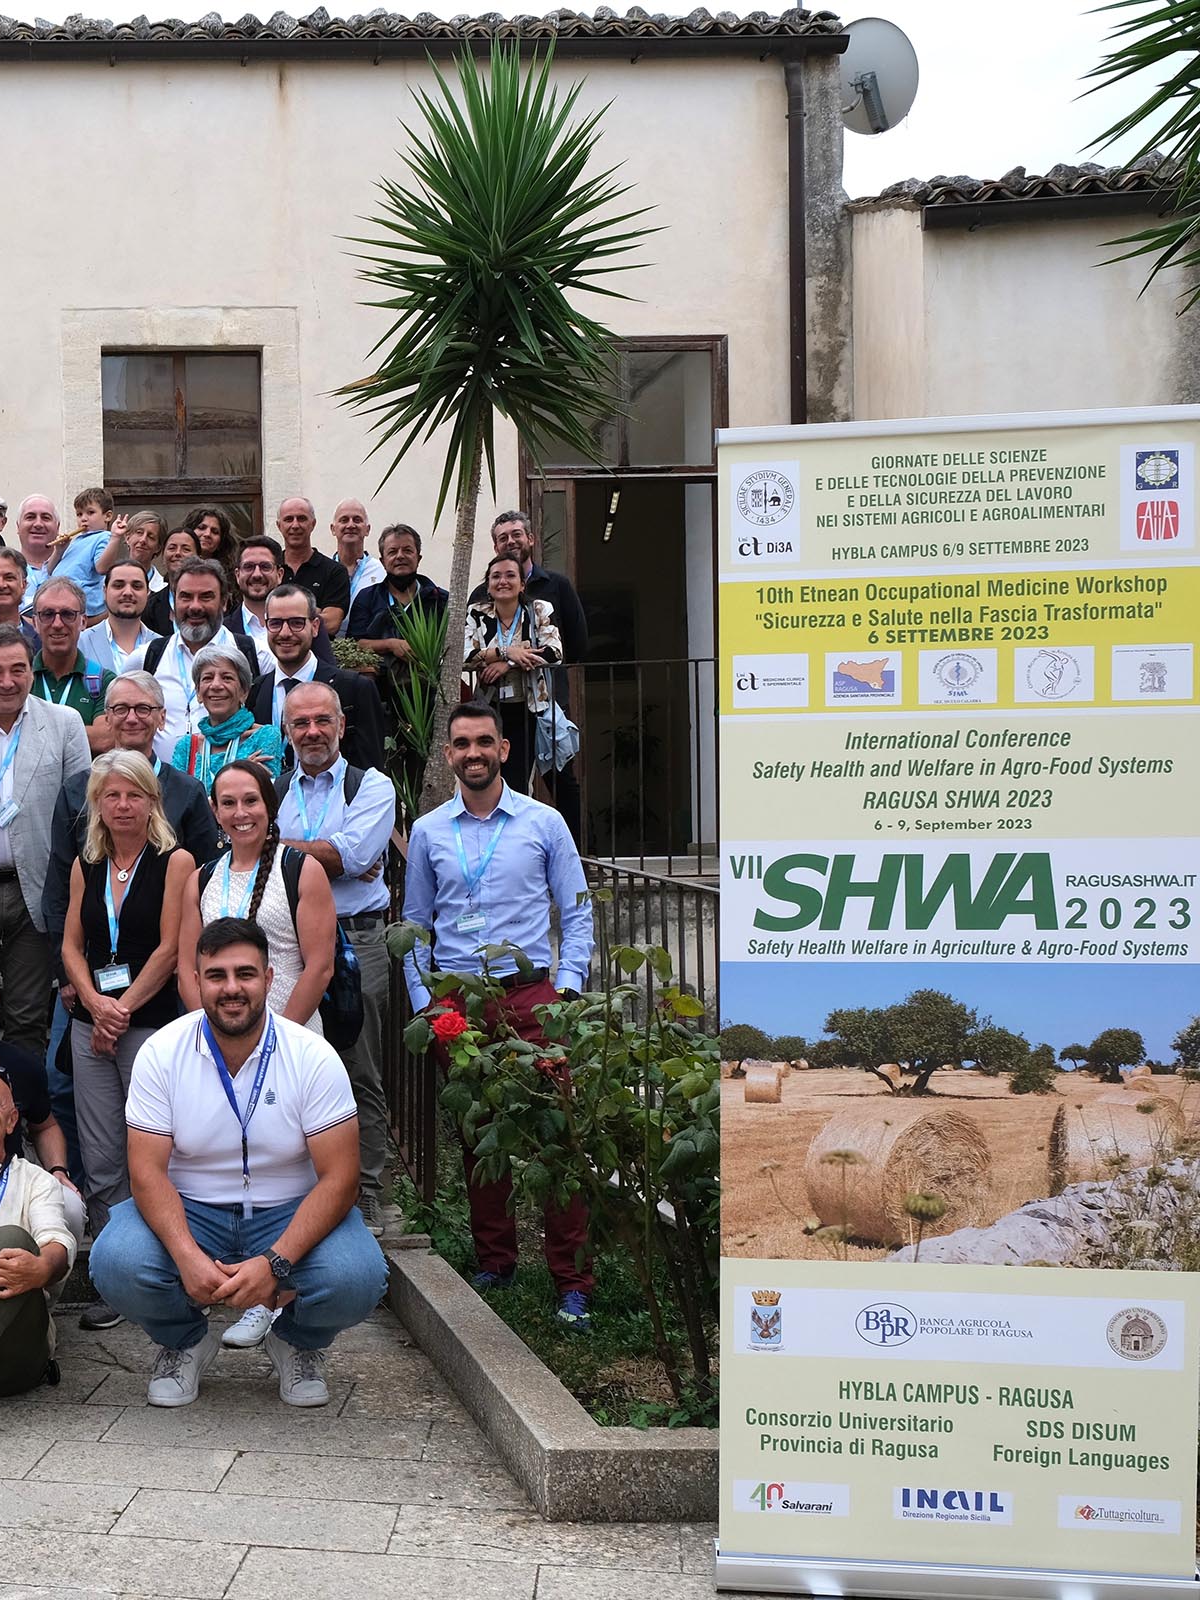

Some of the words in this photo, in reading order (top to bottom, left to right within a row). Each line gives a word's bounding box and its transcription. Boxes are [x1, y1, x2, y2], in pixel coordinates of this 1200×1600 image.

[872, 454, 937, 469] GIORNATE
[944, 452, 984, 465] DELLE
[990, 449, 1046, 464] SCIENZE
[816, 478, 822, 490] E
[828, 476, 868, 490] DELLE
[873, 472, 956, 487] TECNOLOGIE
[962, 470, 1005, 484] DELLA
[1010, 465, 1105, 482] PREVENZIONE
[848, 496, 854, 507] E
[860, 494, 901, 507] DELLA
[907, 490, 981, 505] SICUREZZA
[987, 489, 1012, 502] DEL
[1017, 486, 1072, 500] LAVORO
[817, 515, 837, 527] NEI
[843, 513, 896, 526] SISTEMI
[902, 510, 964, 524] AGRICOLI
[971, 509, 977, 521] E
[983, 504, 1104, 521] AGROALIMENTARI
[767, 541, 793, 554] Di3A
[833, 547, 876, 560] HYBLA
[881, 544, 937, 558] CAMPUS
[943, 543, 963, 557] 6/9
[969, 540, 1050, 555] SETTEMBRE
[1056, 539, 1088, 552] 2023
[757, 587, 793, 604] 10th
[801, 586, 858, 602] Etnean
[866, 581, 979, 603] Occupational
[988, 579, 1069, 596] Medicine
[1076, 575, 1167, 595] Workshop
[756, 613, 845, 629] "Sicurezza
[853, 614, 861, 626] e
[869, 609, 922, 626] Salute
[930, 607, 972, 624] nella
[980, 605, 1036, 623] Fascia
[1044, 602, 1162, 621] Trasformata"
[868, 631, 879, 644] 6
[886, 627, 993, 643] SETTEMBRE
[1001, 626, 1048, 640] 2023
[845, 730, 960, 749] International
[966, 729, 1070, 748] Conference
[753, 762, 805, 782] Safety
[810, 761, 864, 777] Health
[870, 760, 902, 777] and
[909, 759, 973, 776] Welfare
[980, 759, 995, 775] in
[1001, 757, 1092, 779] Agro-Food
[1099, 757, 1173, 777] Systems
[863, 791, 937, 809] RAGUSA
[945, 790, 999, 808] SHWA
[1006, 790, 1052, 808] 2023
[875, 821, 882, 830] 6
[898, 820, 910, 831] 9,
[915, 819, 992, 832] September
[997, 819, 1032, 829] 2023
[730, 856, 762, 879] VII
[1066, 875, 1197, 887] RAGUSASHWA.IT
[753, 853, 1058, 932] SHWA
[748, 940, 793, 958] Safety
[798, 940, 845, 954] Health
[852, 940, 908, 954] Welfare
[913, 940, 926, 954] in
[931, 940, 1015, 958] Agriculture
[1022, 940, 1032, 955] &
[1037, 940, 1118, 958] Agro-Food
[1123, 940, 1188, 959] Systems
[920, 1318, 954, 1327] BANCA
[958, 1319, 1011, 1328] AGRICOLA
[920, 1327, 973, 1336] POPOLARE
[978, 1328, 989, 1336] DI
[992, 1329, 1033, 1338] RAGUSA
[840, 1381, 897, 1401] HYBLA
[904, 1383, 979, 1404] CAMPUS
[1000, 1387, 1073, 1409] RAGUSA
[746, 1408, 831, 1428] Consorzio
[840, 1412, 953, 1433] Universitario
[1027, 1420, 1064, 1439] SDS
[1073, 1423, 1135, 1441] DISUM
[761, 1434, 842, 1454] Provincia
[850, 1438, 864, 1454] di
[872, 1439, 938, 1460] Ragusa
[994, 1445, 1061, 1468] Foreign
[1069, 1448, 1169, 1472] Languages
[782, 1500, 832, 1512] Salvarani
[1098, 1507, 1159, 1522] Tuttagricoltura
[935, 1513, 968, 1521] Regionale
